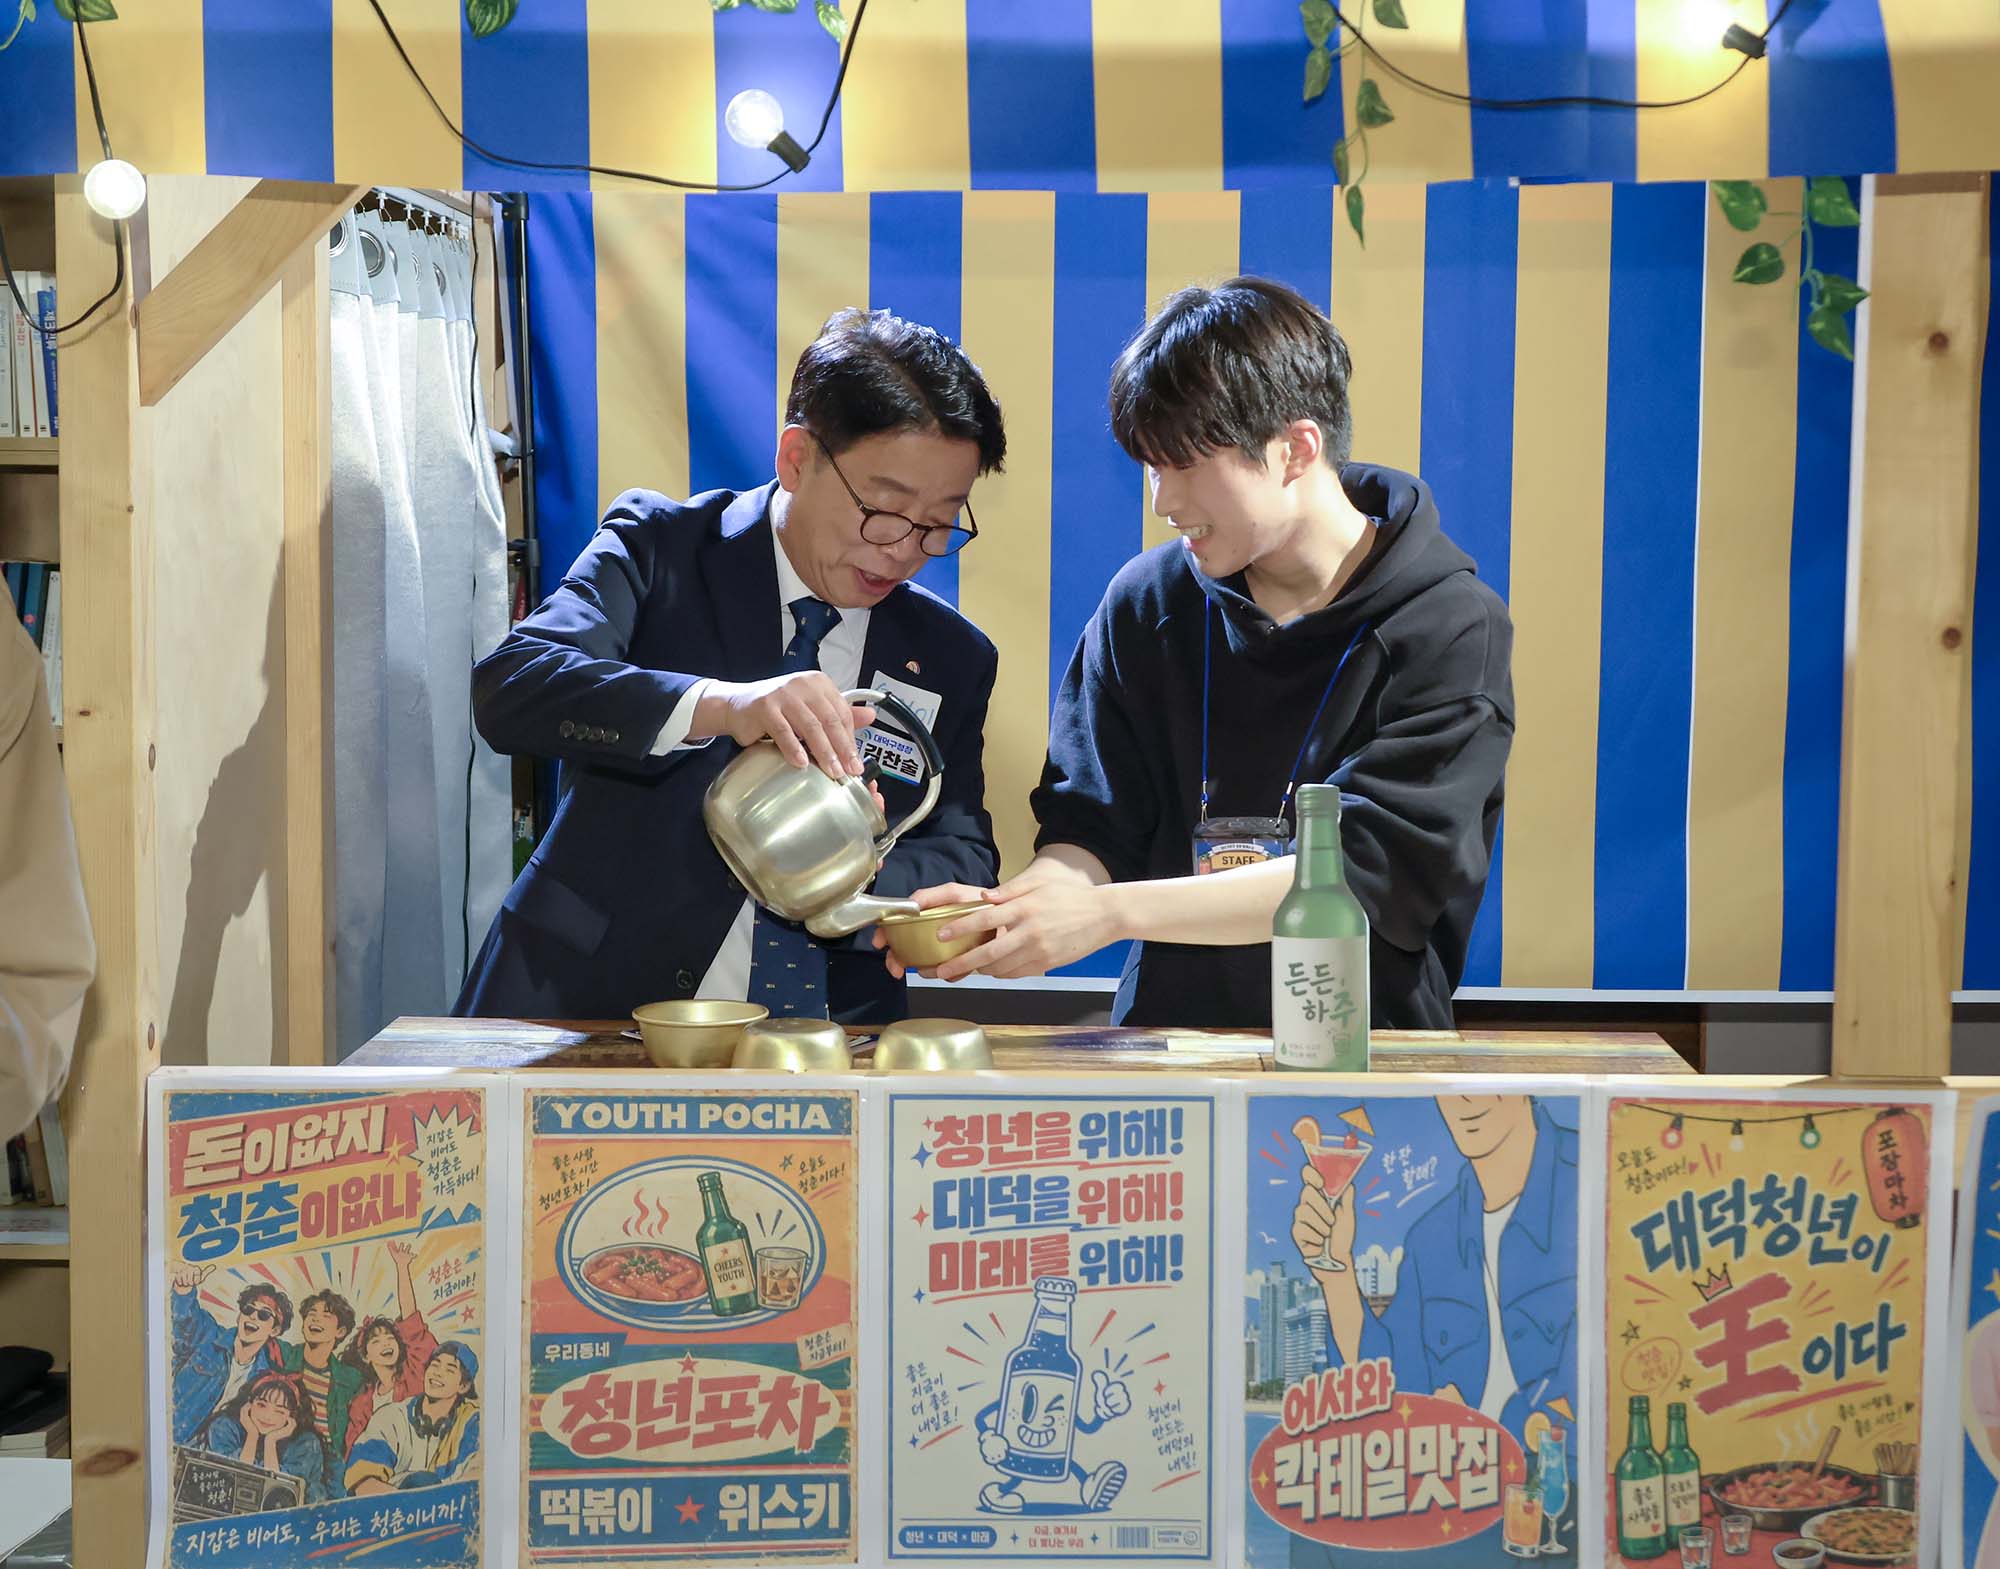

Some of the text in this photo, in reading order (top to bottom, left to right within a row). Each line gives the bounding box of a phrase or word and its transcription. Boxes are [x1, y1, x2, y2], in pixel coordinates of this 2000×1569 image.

[873, 733, 913, 754] 대덕구청장
[864, 742, 919, 777] 김찬술
[1222, 856, 1255, 865] STAFF
[1284, 962, 1335, 997] 든든
[552, 1102, 832, 1130] YOUTH POCHA
[184, 1104, 387, 1188] 돈이없지
[427, 1128, 454, 1146] 지갑은
[431, 1141, 458, 1158] 비어도
[932, 1107, 1184, 1168] 청년을 위해!
[427, 1156, 461, 1181] 청춘은
[799, 1155, 825, 1176] 오늘도
[1616, 1146, 1656, 1172] 오늘도
[1878, 1129, 1908, 1209] 포장마차
[433, 1164, 479, 1196] 가득하다!
[932, 1171, 1184, 1230] 대덕을 위해!
[1630, 1174, 1891, 1274] 대덕청년이
[428, 1257, 462, 1285] 청춘은
[714, 1257, 743, 1272] CHEERS
[718, 1269, 744, 1283] YOUTH
[929, 1233, 1184, 1292] 미래를 위해!
[434, 1271, 476, 1300] 지금이야!
[544, 1341, 610, 1362] 우리동네
[1803, 1303, 1906, 1381] 이다
[906, 1362, 927, 1383] 좋은
[912, 1372, 943, 1397] 지금이
[912, 1391, 950, 1416] 더 좋은
[1283, 1360, 1394, 1431] 어서와
[558, 1374, 831, 1456] 청년포차
[919, 1406, 958, 1432] 내일로!
[1148, 1398, 1181, 1423] 청년이
[1168, 1451, 1196, 1472] 내일!
[1274, 1424, 1499, 1522] 칵테일맛집
[540, 1482, 840, 1536] 떡볶이 위스키
[186, 1496, 466, 1555] 지갑은 비어도, 우리는 청춘이니까!
